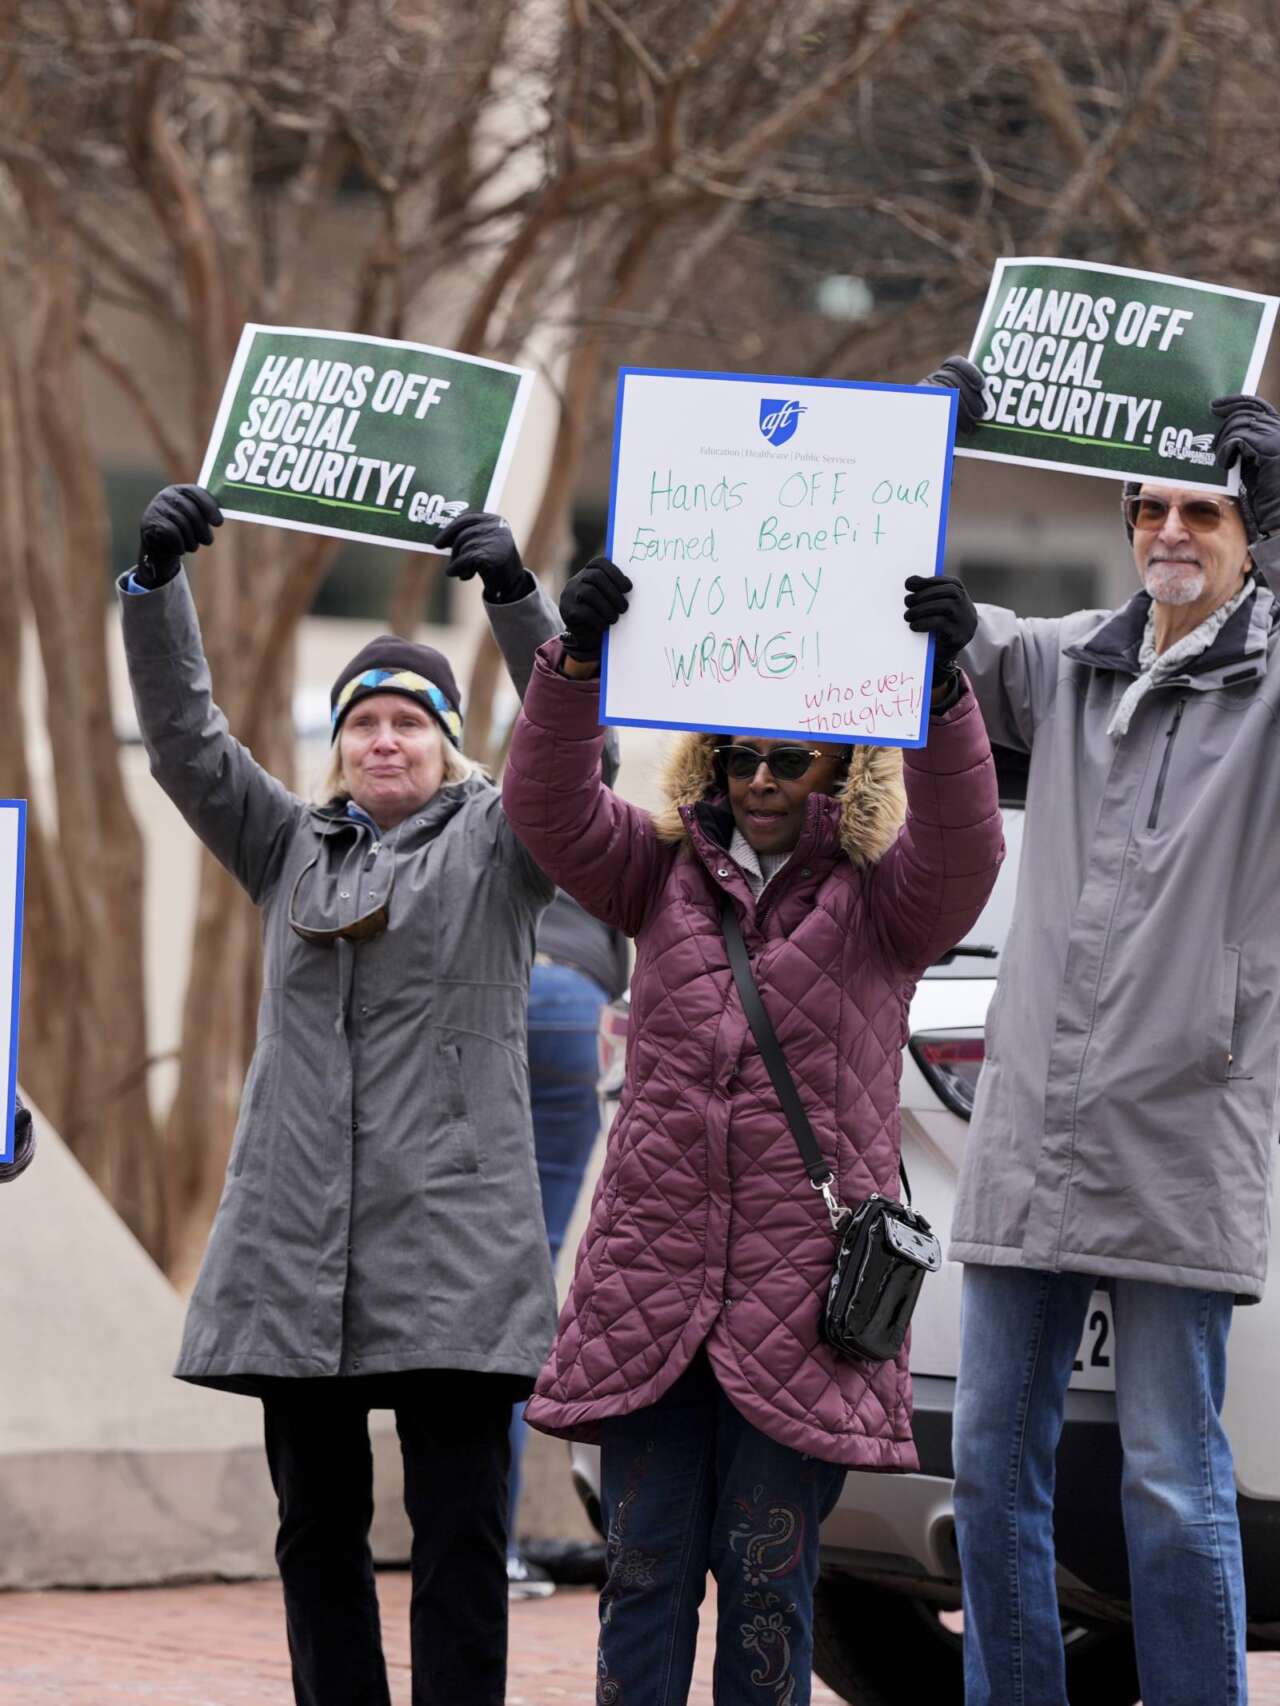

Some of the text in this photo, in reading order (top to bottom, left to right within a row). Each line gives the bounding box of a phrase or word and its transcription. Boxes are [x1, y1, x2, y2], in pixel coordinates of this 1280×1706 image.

[995, 287, 1194, 351] HANDS OFF
[251, 355, 451, 420] HANDS OFF
[983, 330, 1105, 389] SOCIAL
[239, 397, 362, 453] SOCIAL
[761, 399, 809, 440] aft
[981, 376, 1163, 445] SECURITY!
[224, 440, 417, 509] SECURITY!
[699, 446, 857, 465] Education Healthcare Public Services
[649, 469, 749, 516] Hands
[628, 513, 887, 563] Earned Benefit
[668, 566, 823, 621] NO WAY
